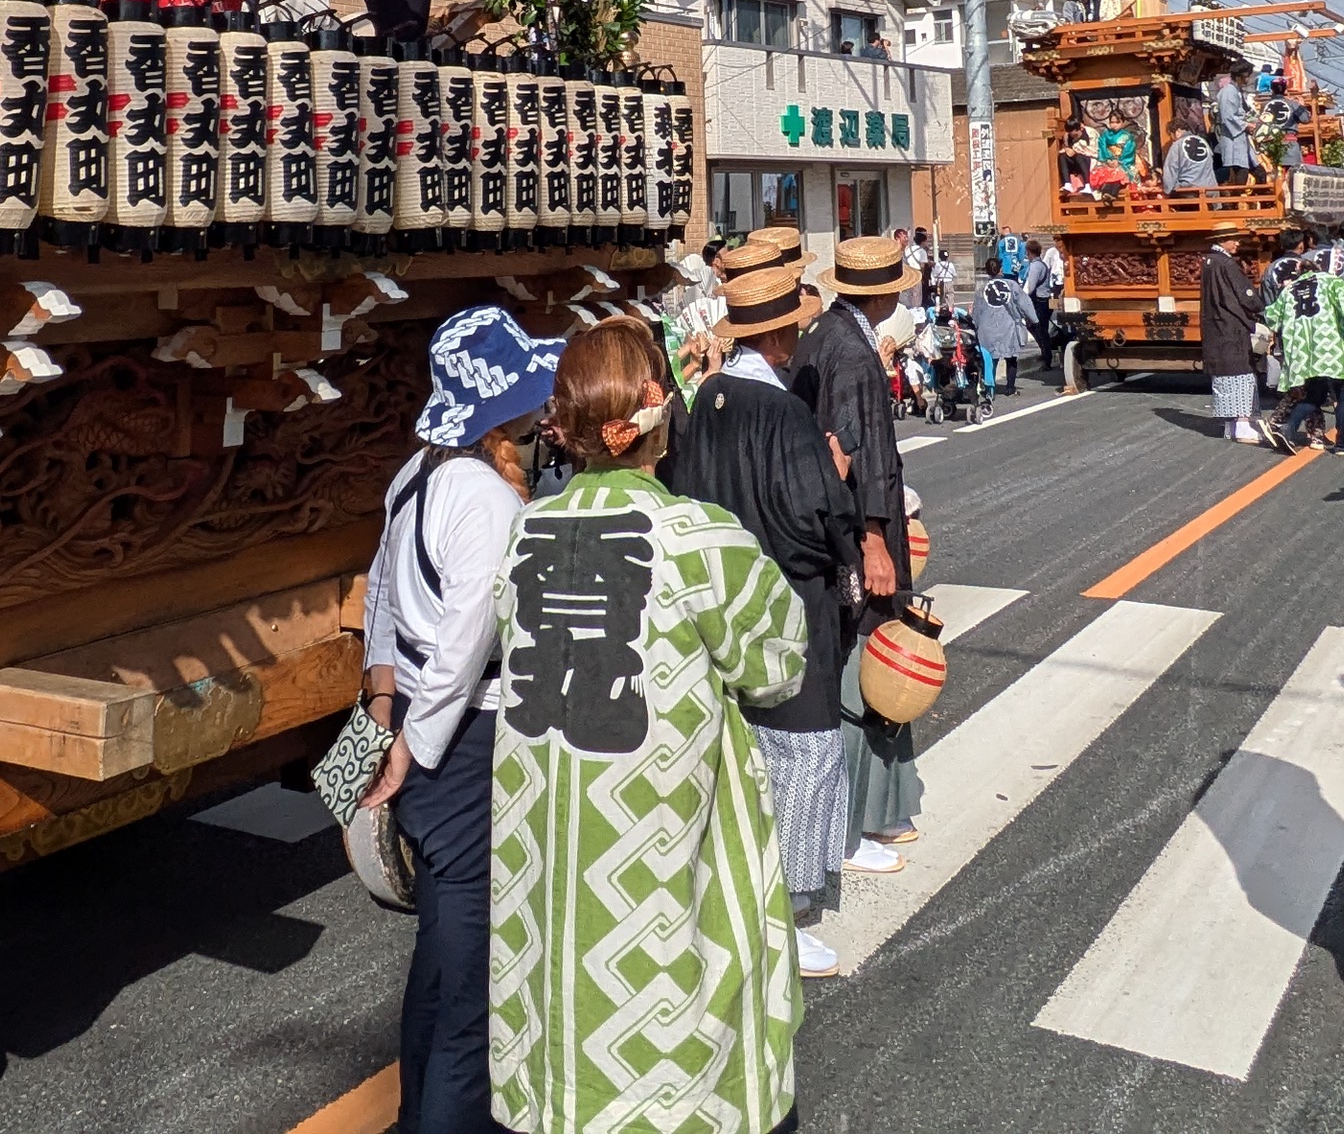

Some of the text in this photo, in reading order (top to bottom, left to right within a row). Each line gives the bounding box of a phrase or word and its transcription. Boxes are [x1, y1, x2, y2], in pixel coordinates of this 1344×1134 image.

[64, 19, 108, 200] 香丸町
[125, 34, 167, 208] 香丸町
[179, 41, 220, 211] 香丸町
[228, 46, 268, 207] 香丸町
[277, 52, 317, 205] 香丸町
[326, 62, 361, 212] 香丸町
[364, 68, 399, 216] 香丸町
